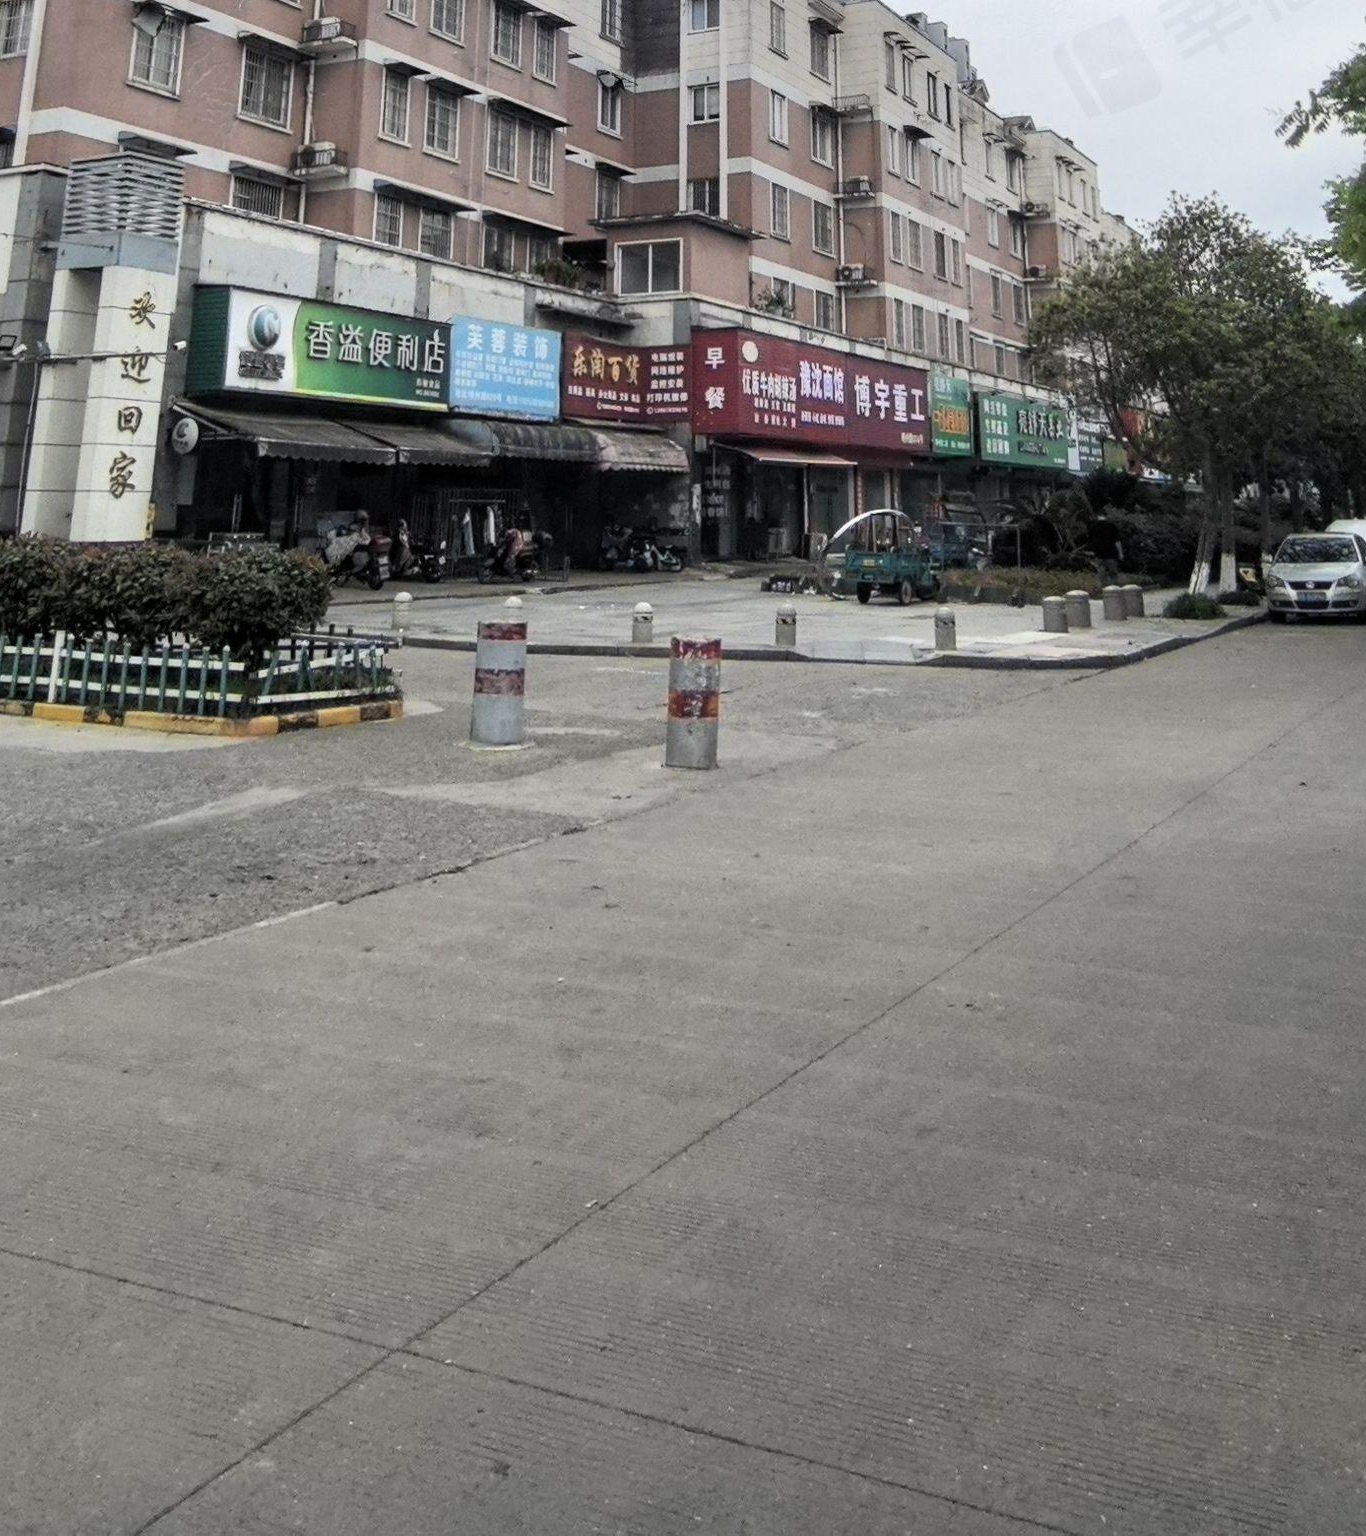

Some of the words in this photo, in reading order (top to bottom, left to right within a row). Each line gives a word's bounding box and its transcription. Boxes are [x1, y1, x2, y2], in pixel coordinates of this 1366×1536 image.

[306, 320, 446, 374] 香溢便利店
[466, 324, 550, 360] 芙蓉装饰
[108, 291, 157, 499] 欢迎回家
[705, 347, 725, 409] 早餐
[854, 374, 925, 423] 博宇重工
